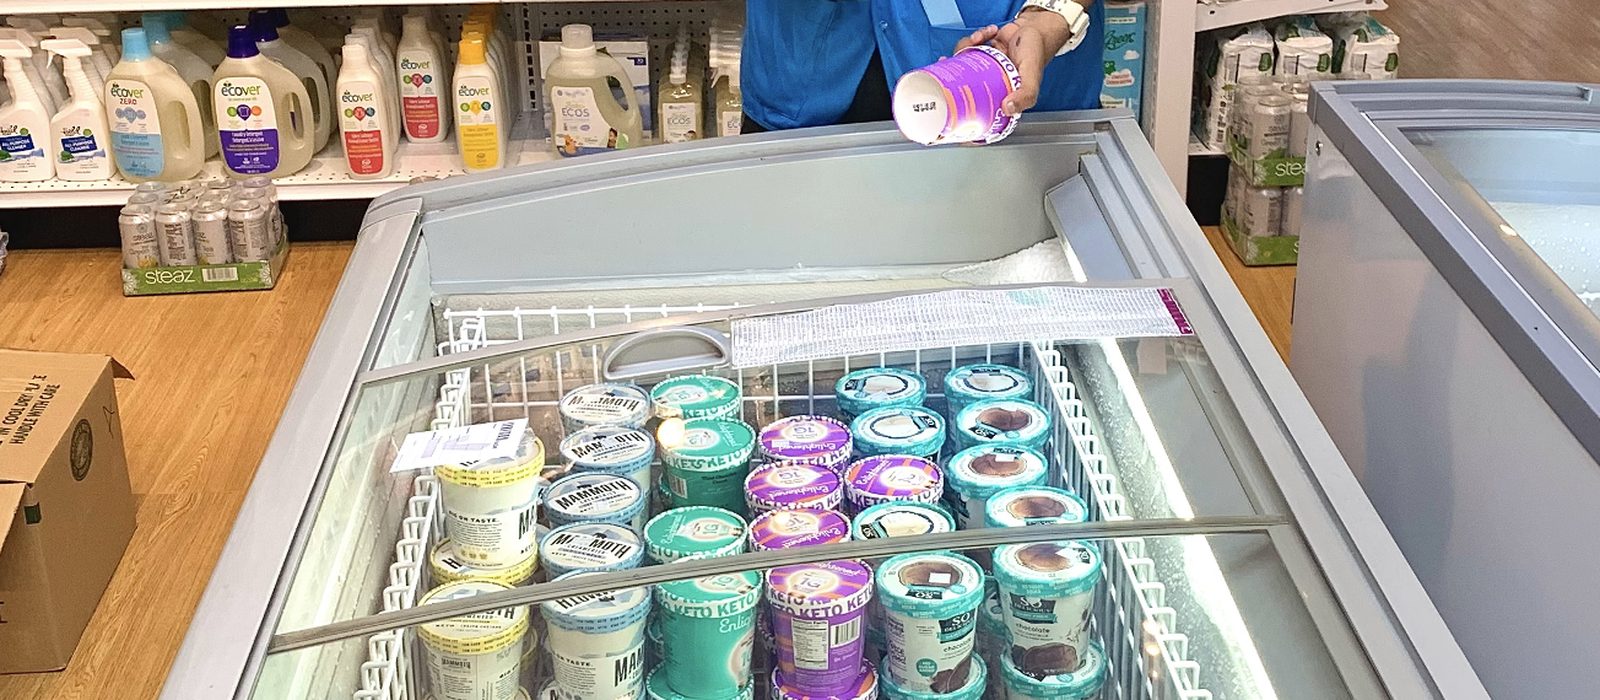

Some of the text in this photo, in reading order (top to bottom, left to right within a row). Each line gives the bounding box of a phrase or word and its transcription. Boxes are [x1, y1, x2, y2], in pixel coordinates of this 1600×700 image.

[401, 59, 430, 70] ecover
[111, 86, 144, 99] ecover
[221, 85, 261, 97] ecover
[458, 86, 490, 97] ecover
[341, 92, 373, 103] ecover
[561, 108, 590, 118] ECOS
[666, 117, 692, 126] ECOS
[145, 267, 196, 285] steaz
[555, 480, 633, 510] MAMMOTH
[717, 592, 755, 617] KETO
[801, 605, 843, 619] KETO
[951, 612, 970, 627] SO
